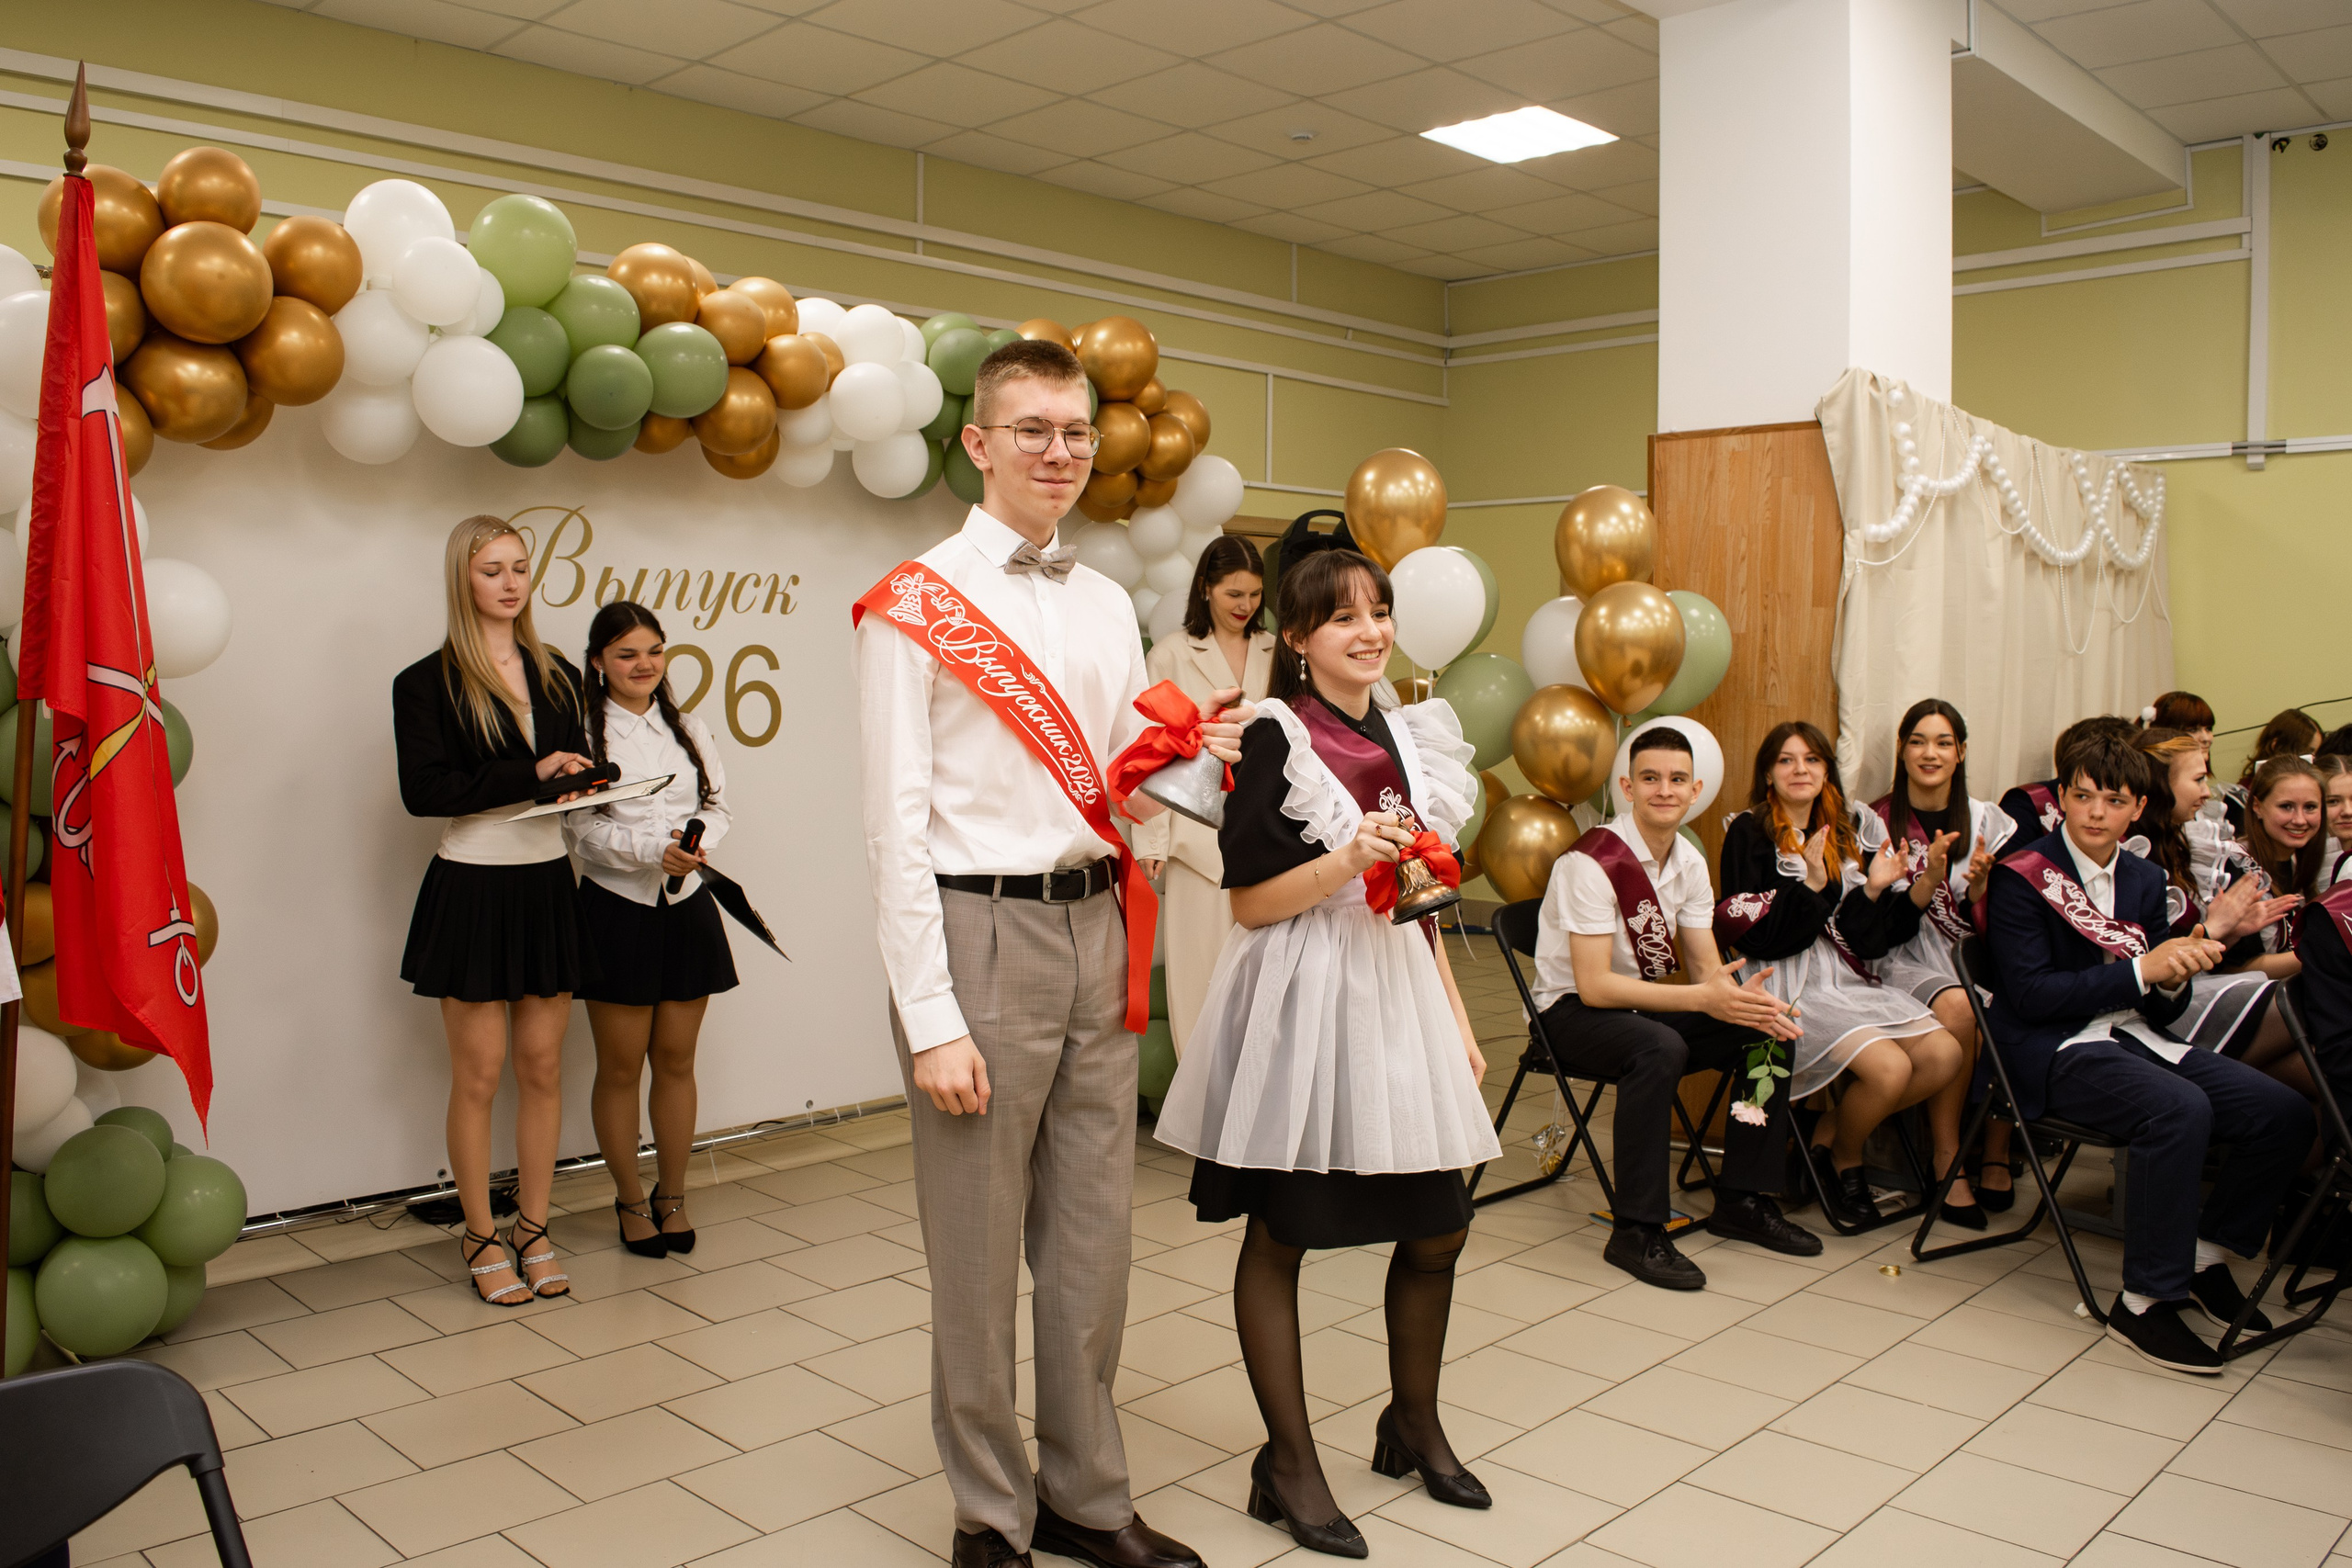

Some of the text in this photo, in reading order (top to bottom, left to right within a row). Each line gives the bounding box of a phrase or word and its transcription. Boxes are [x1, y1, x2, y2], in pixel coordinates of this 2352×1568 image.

[508, 505, 800, 631] Выпуск
[928, 614, 1102, 805] Выпускник 2026
